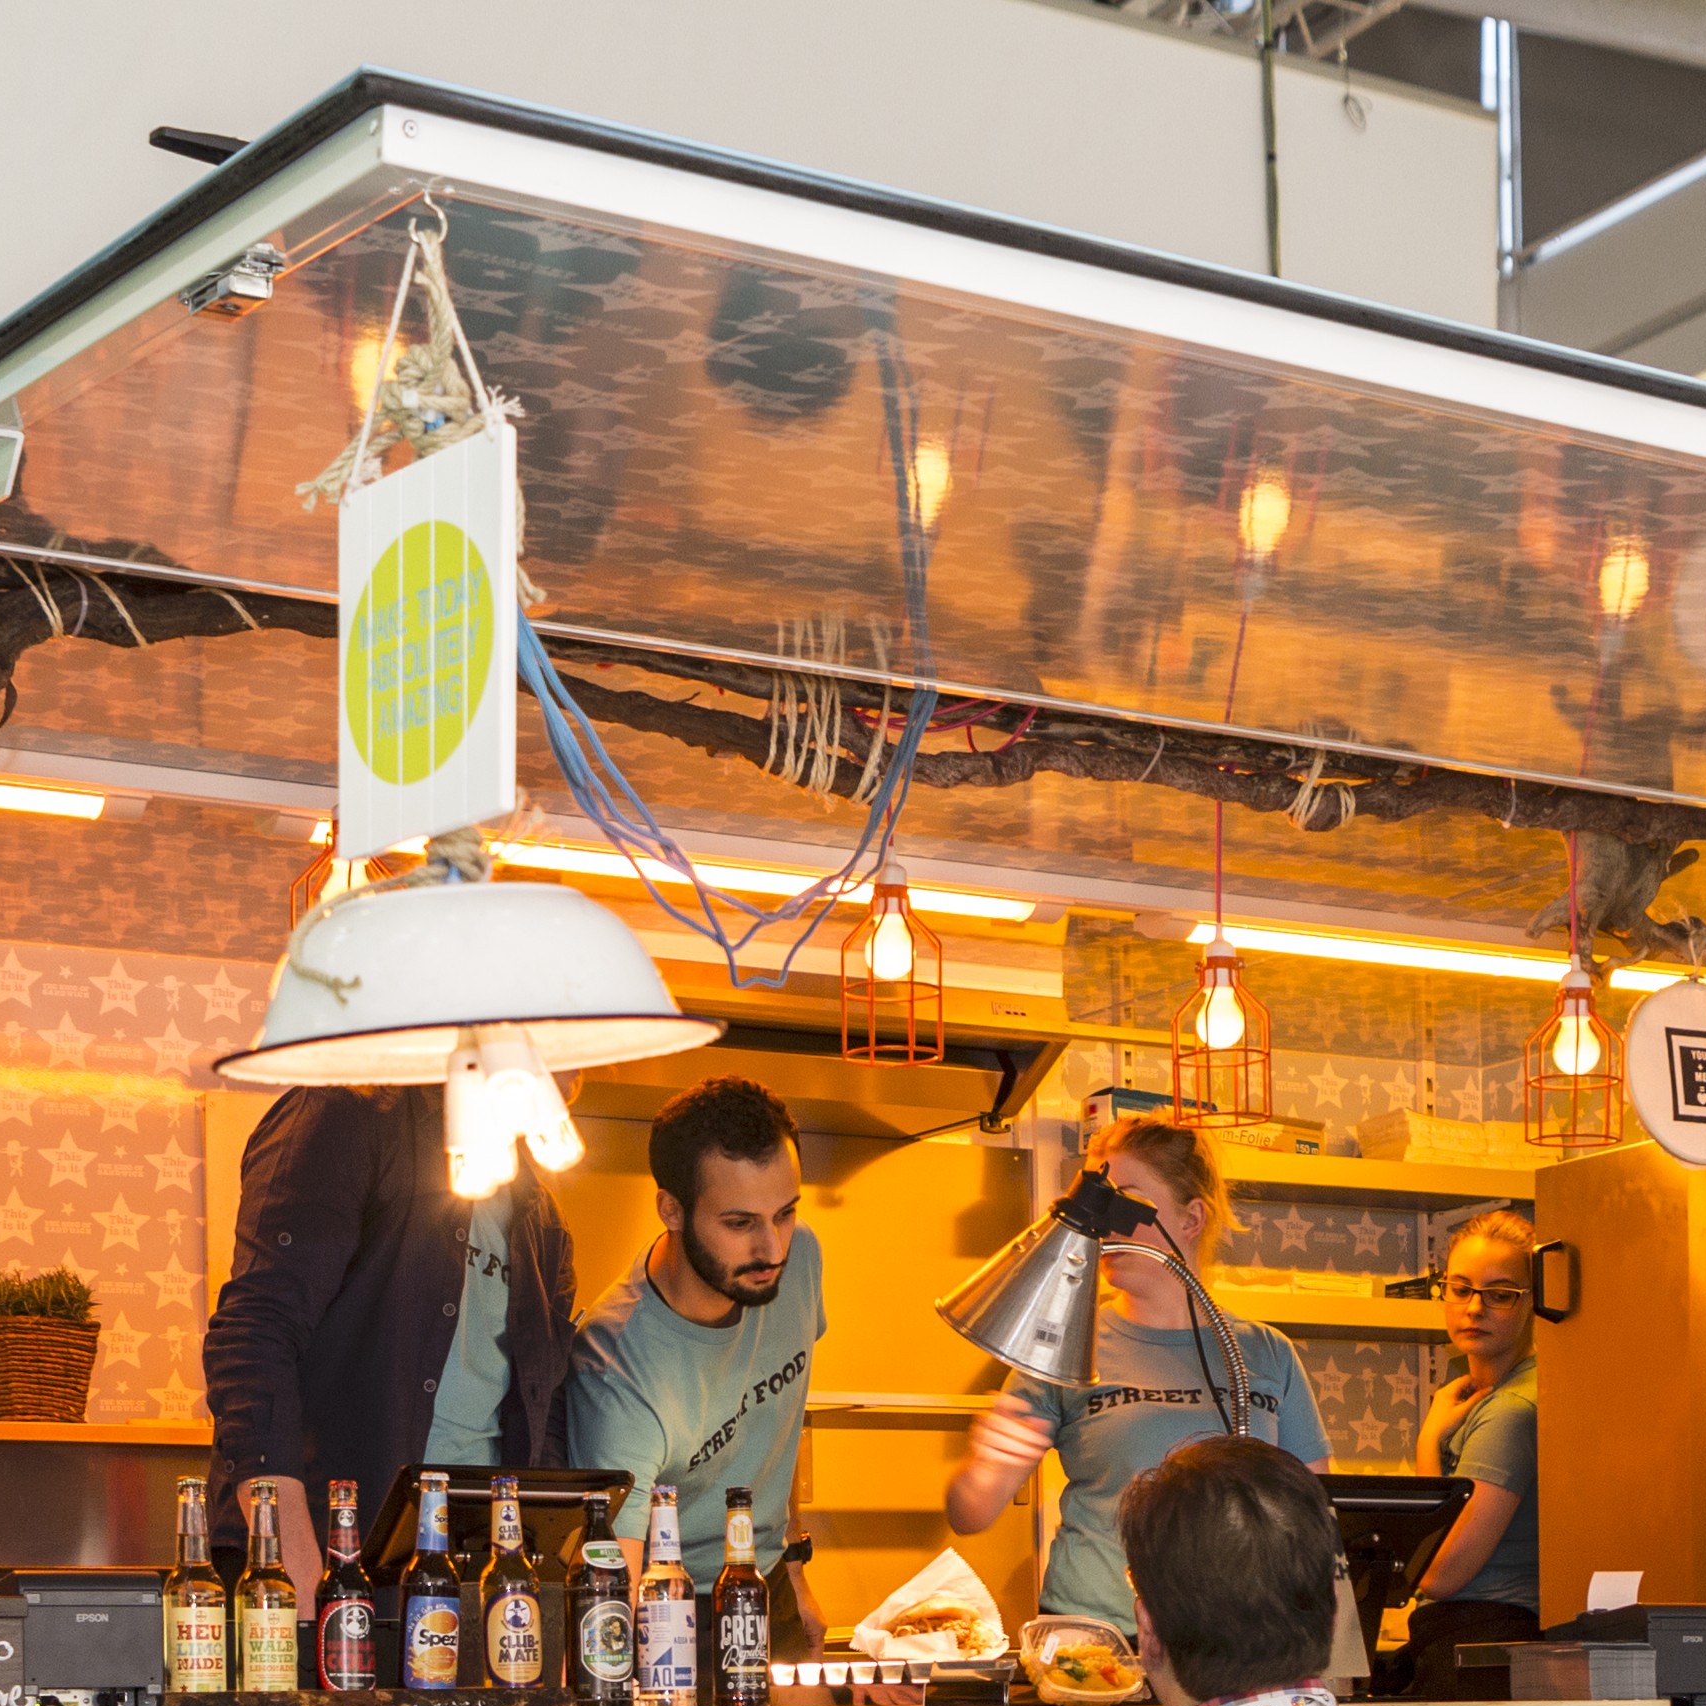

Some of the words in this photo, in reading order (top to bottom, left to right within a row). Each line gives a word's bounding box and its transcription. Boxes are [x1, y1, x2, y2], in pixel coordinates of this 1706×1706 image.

[357, 595, 409, 653] MAKE
[415, 566, 485, 624] TODAY
[368, 619, 481, 694] ABSOLUTELY
[378, 675, 463, 741] AMAZING
[687, 1392, 749, 1474] STRET
[753, 1350, 807, 1405] FOOD
[1088, 1386, 1202, 1415] STREET
[75, 1612, 109, 1624] EPSON
[177, 1624, 223, 1641] HEU
[720, 1614, 768, 1650] CREW
[1682, 1635, 1704, 1644] EPSON
[177, 1642, 224, 1657] LIMO
[498, 1649, 539, 1663] MATE
[177, 1657, 224, 1671] NADE
